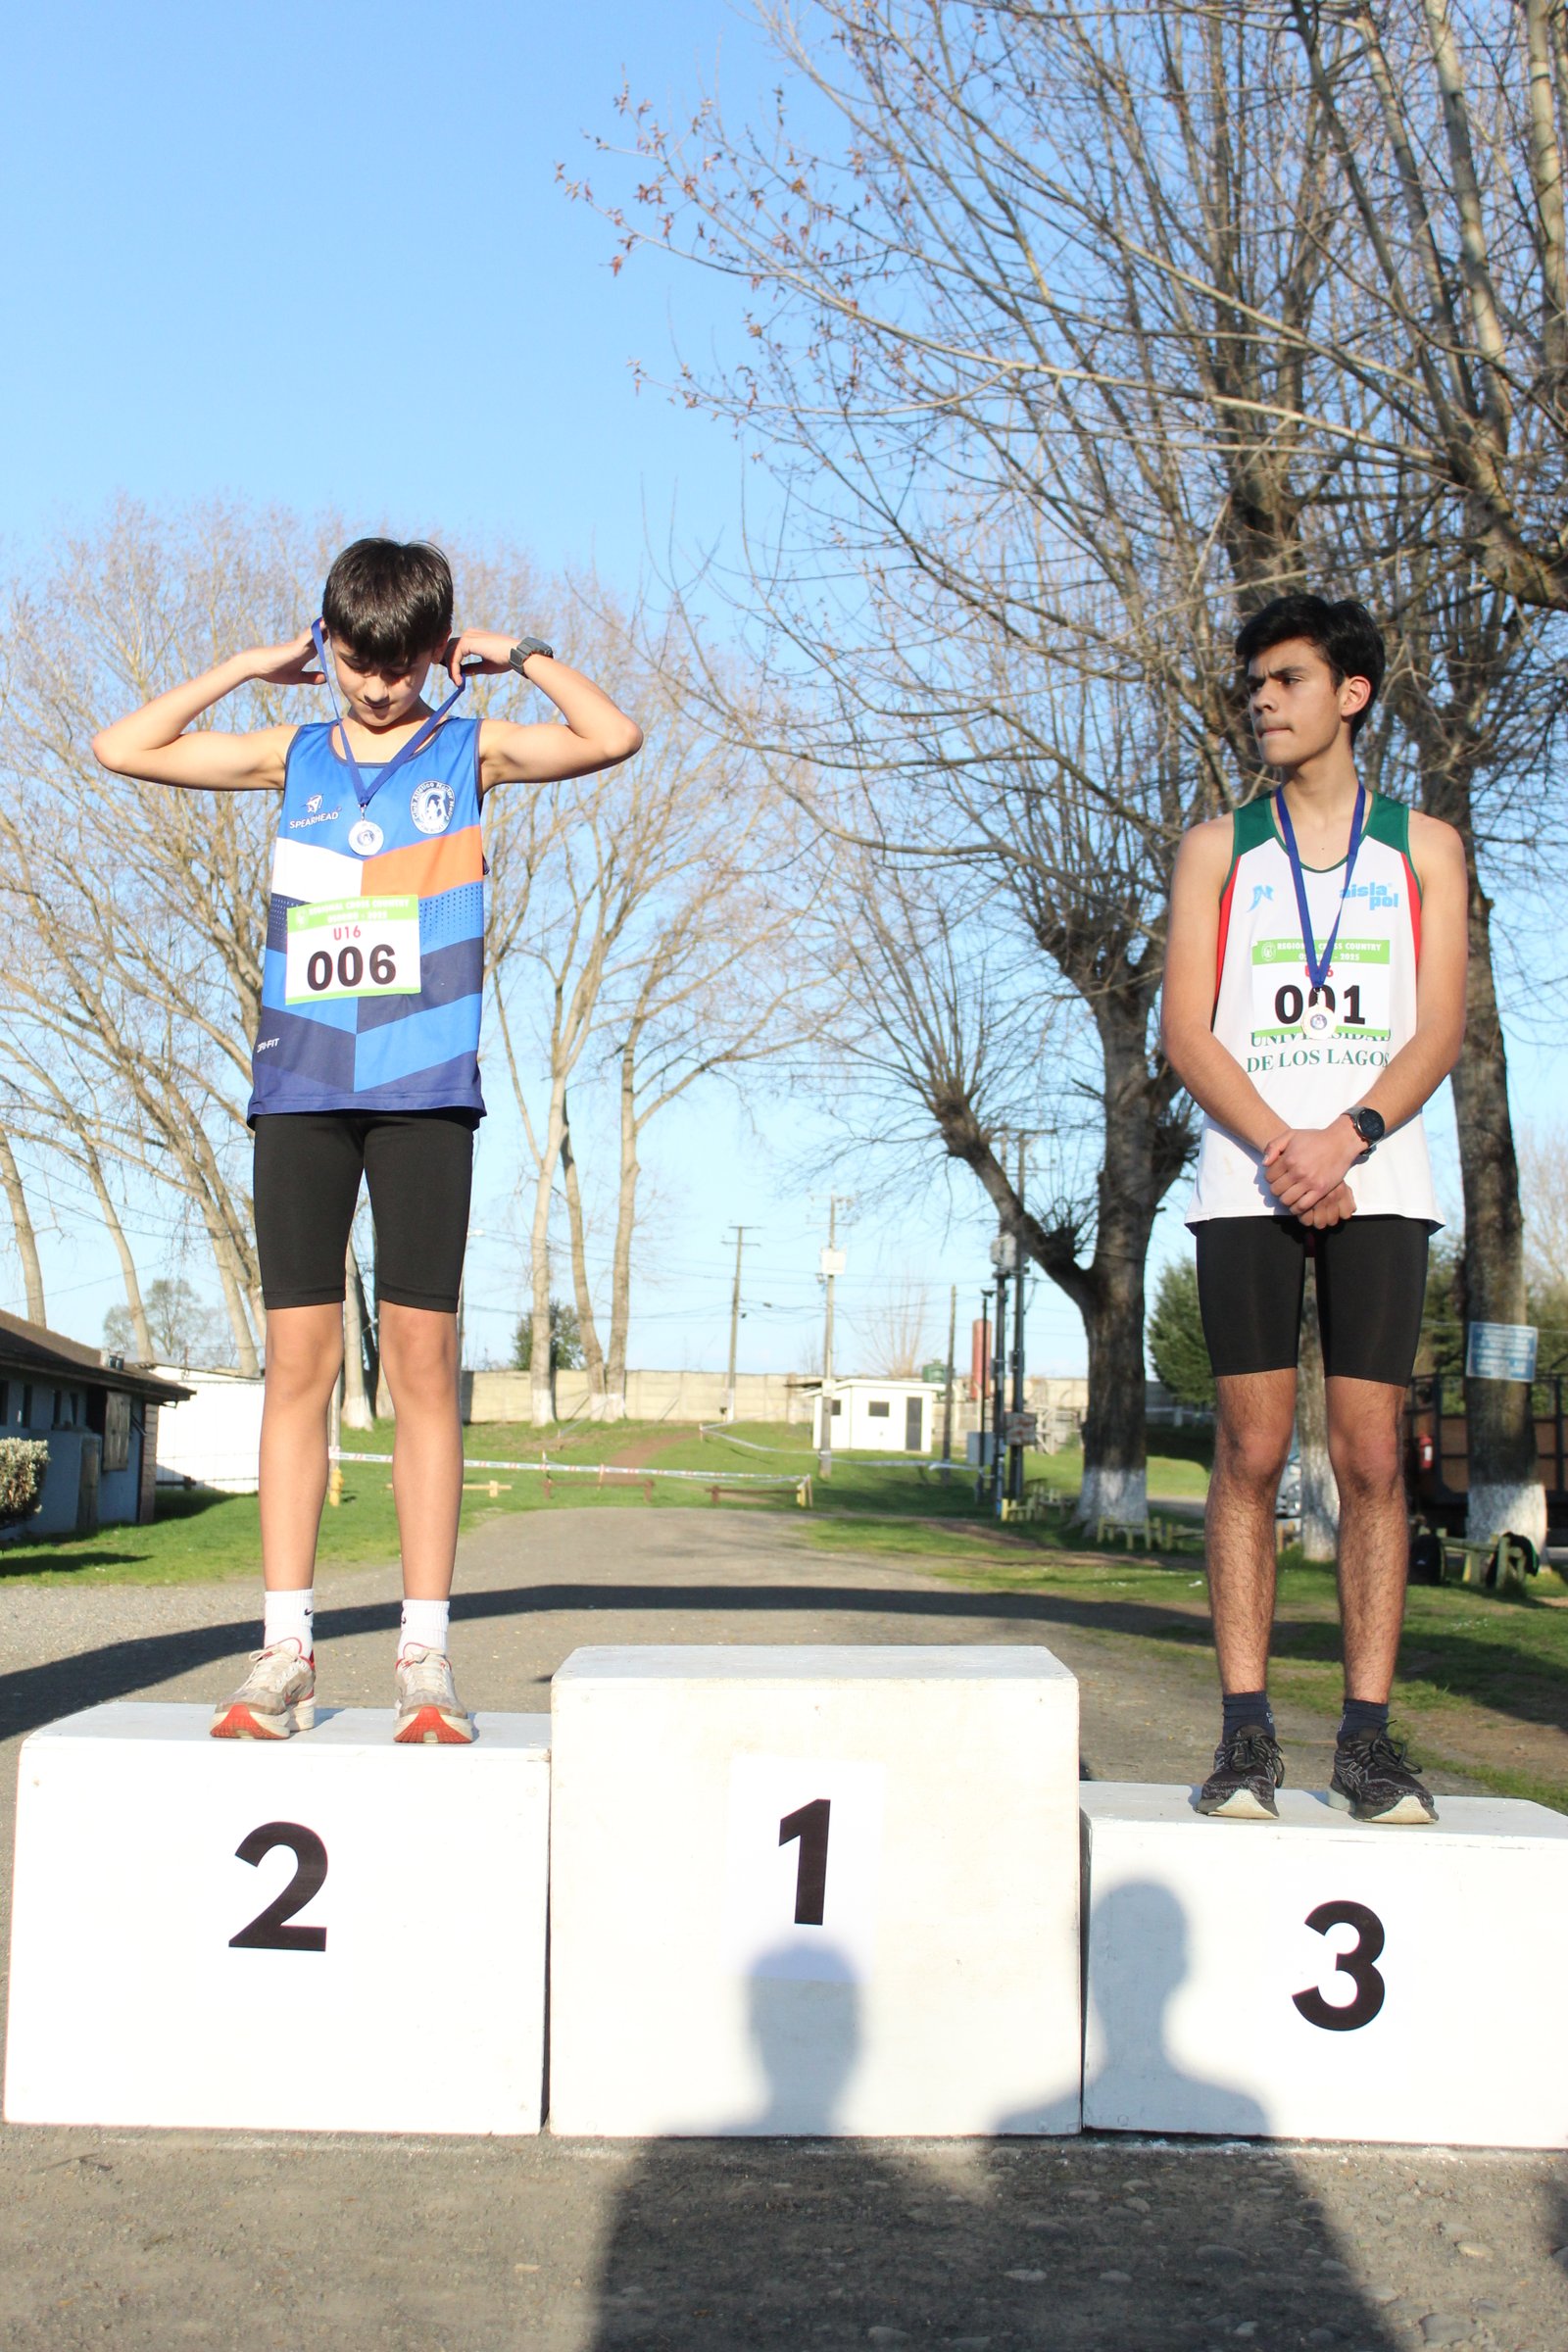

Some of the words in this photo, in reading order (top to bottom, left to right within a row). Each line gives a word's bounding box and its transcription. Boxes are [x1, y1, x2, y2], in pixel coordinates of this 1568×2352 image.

[289, 811, 339, 829] SPEARHEAD
[1339, 882, 1388, 899] aisla
[1370, 893, 1398, 910] pol
[333, 925, 362, 941] U16
[1277, 942, 1306, 951] REGION
[307, 944, 397, 992] 006
[1275, 984, 1365, 1025] 001
[1247, 1055, 1274, 1073] DE
[1279, 1050, 1320, 1068] LOS
[1327, 1049, 1390, 1068] LAGOS
[778, 1798, 831, 1926] 1
[228, 1821, 328, 1952] 2
[1292, 1899, 1386, 2032] 3
